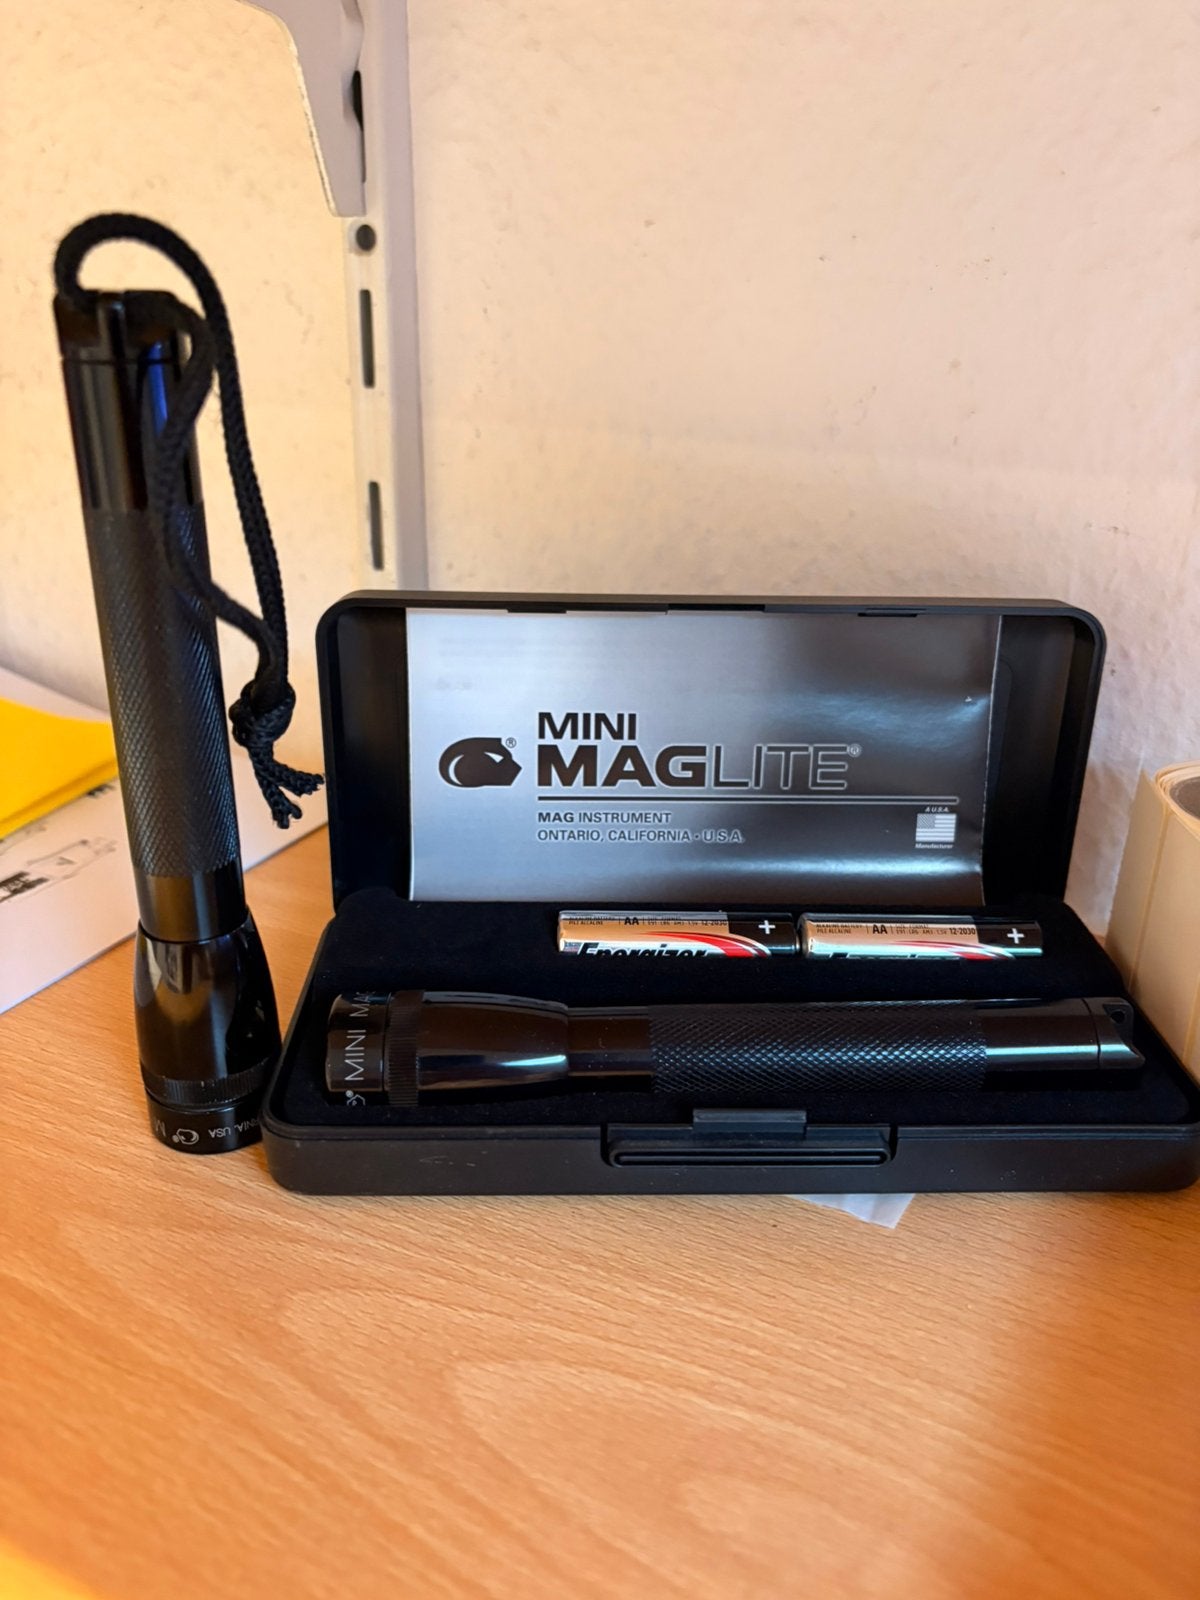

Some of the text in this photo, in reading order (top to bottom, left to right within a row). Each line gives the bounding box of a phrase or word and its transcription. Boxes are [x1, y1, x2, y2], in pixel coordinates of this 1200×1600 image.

[537, 711, 638, 741] MINI
[537, 811, 672, 824] MAG INSTRUMENT
[537, 829, 604, 842] ONTARIO,
[607, 829, 691, 842] CALIFORNIA
[624, 916, 640, 926] AA
[872, 924, 888, 934] AA
[949, 927, 976, 935] 12-2030
[344, 1030, 367, 1080] MINI
[208, 1126, 232, 1139] USA
